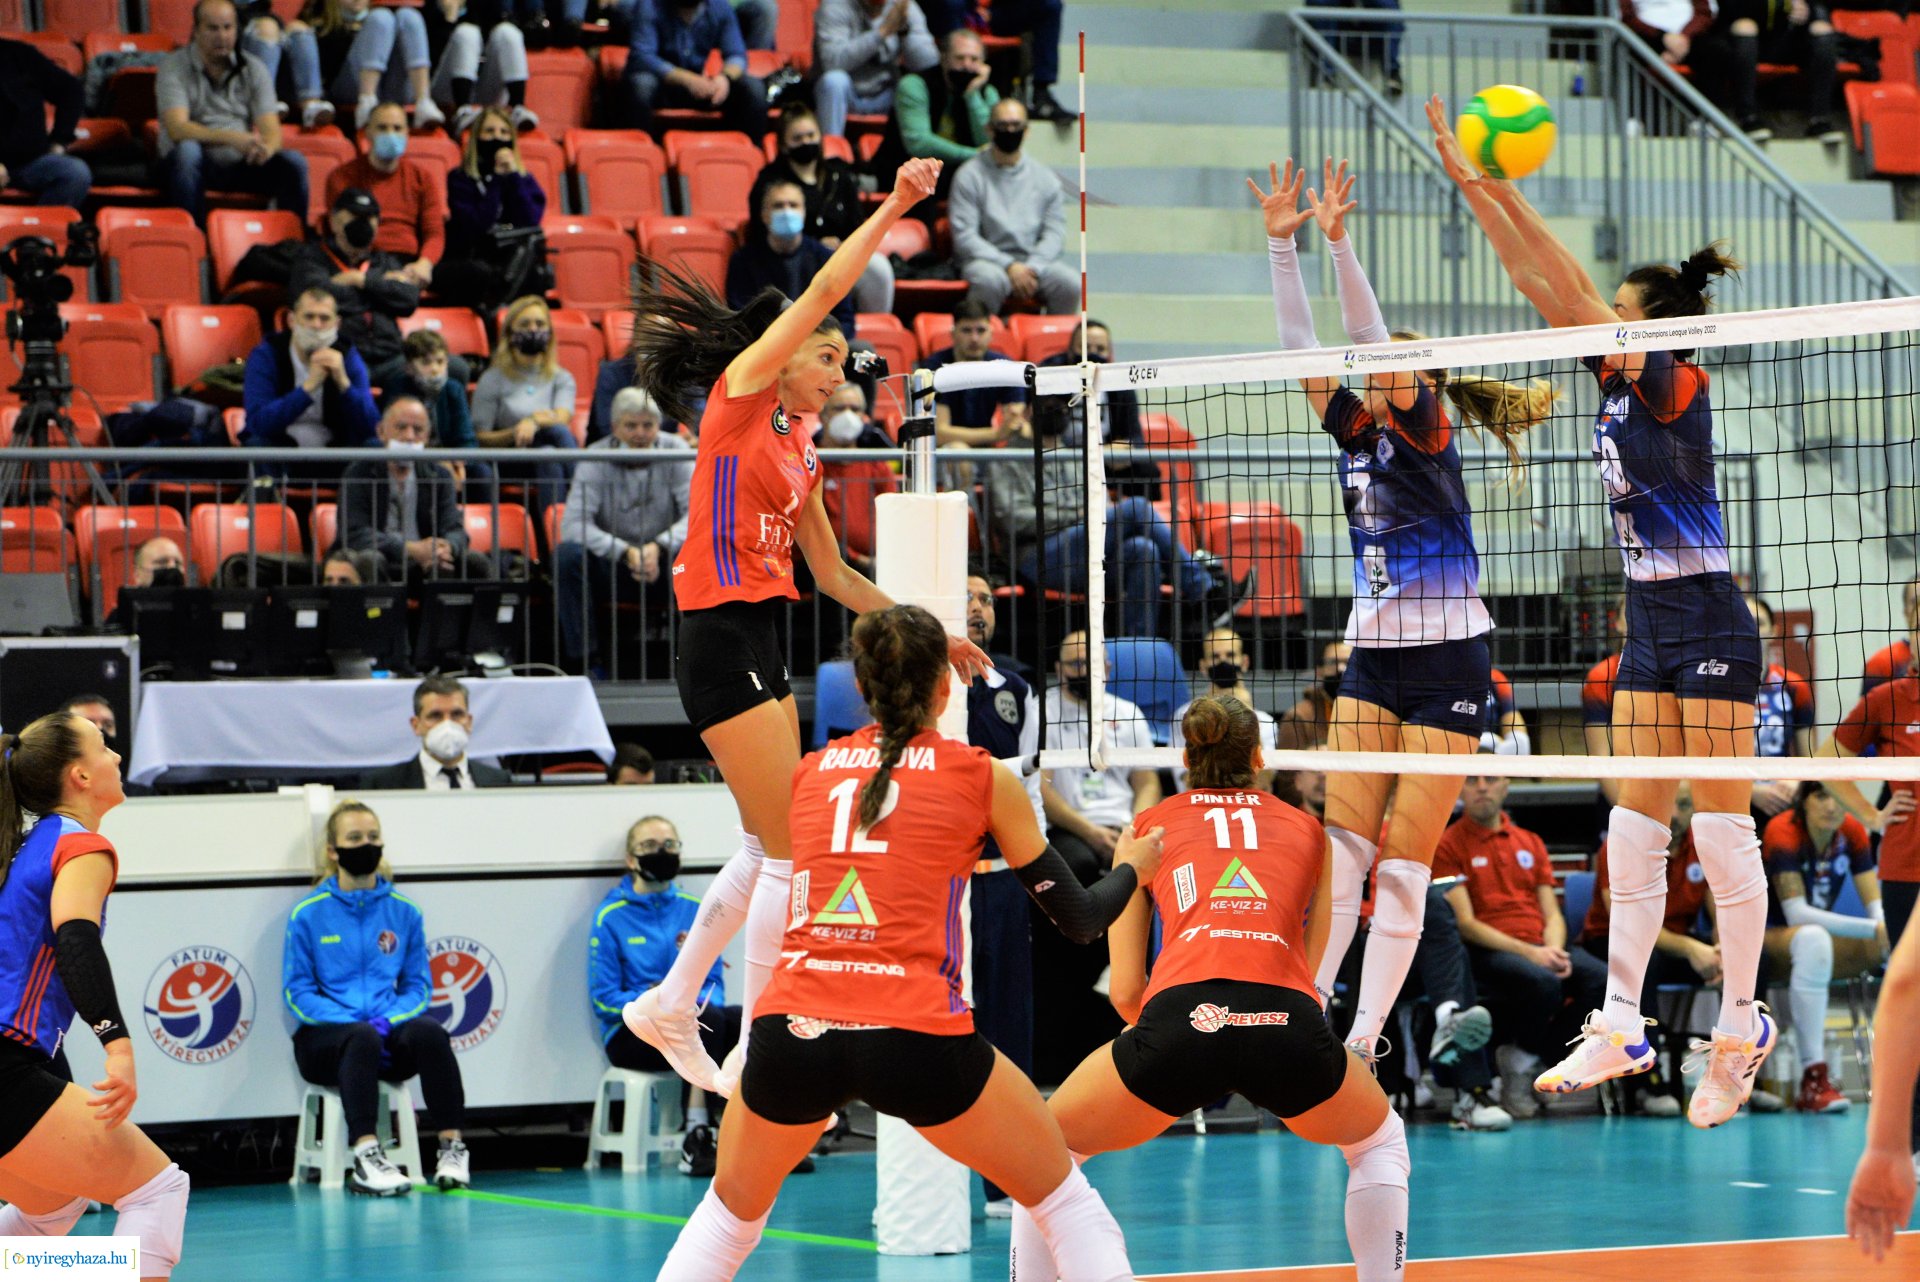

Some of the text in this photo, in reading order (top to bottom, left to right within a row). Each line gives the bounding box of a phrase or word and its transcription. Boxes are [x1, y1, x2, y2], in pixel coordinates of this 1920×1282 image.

[1631, 325, 1717, 340] CEV Champions League Volley 2022
[1358, 349, 1433, 362] CEV Champions League Volley 2022
[1141, 367, 1158, 379] CEV
[1191, 792, 1262, 806] PINTÉR
[828, 778, 900, 853] 12
[1204, 807, 1259, 850] 11
[1210, 900, 1266, 910] KE-VIZ 21
[811, 926, 876, 941] KE-VIZ 21
[1209, 929, 1289, 949] BESTRON
[171, 949, 227, 968] FATUM
[804, 958, 906, 976] BESTRONG
[1227, 1012, 1288, 1025] REVESZ
[1394, 1230, 1406, 1270] MIKASA
